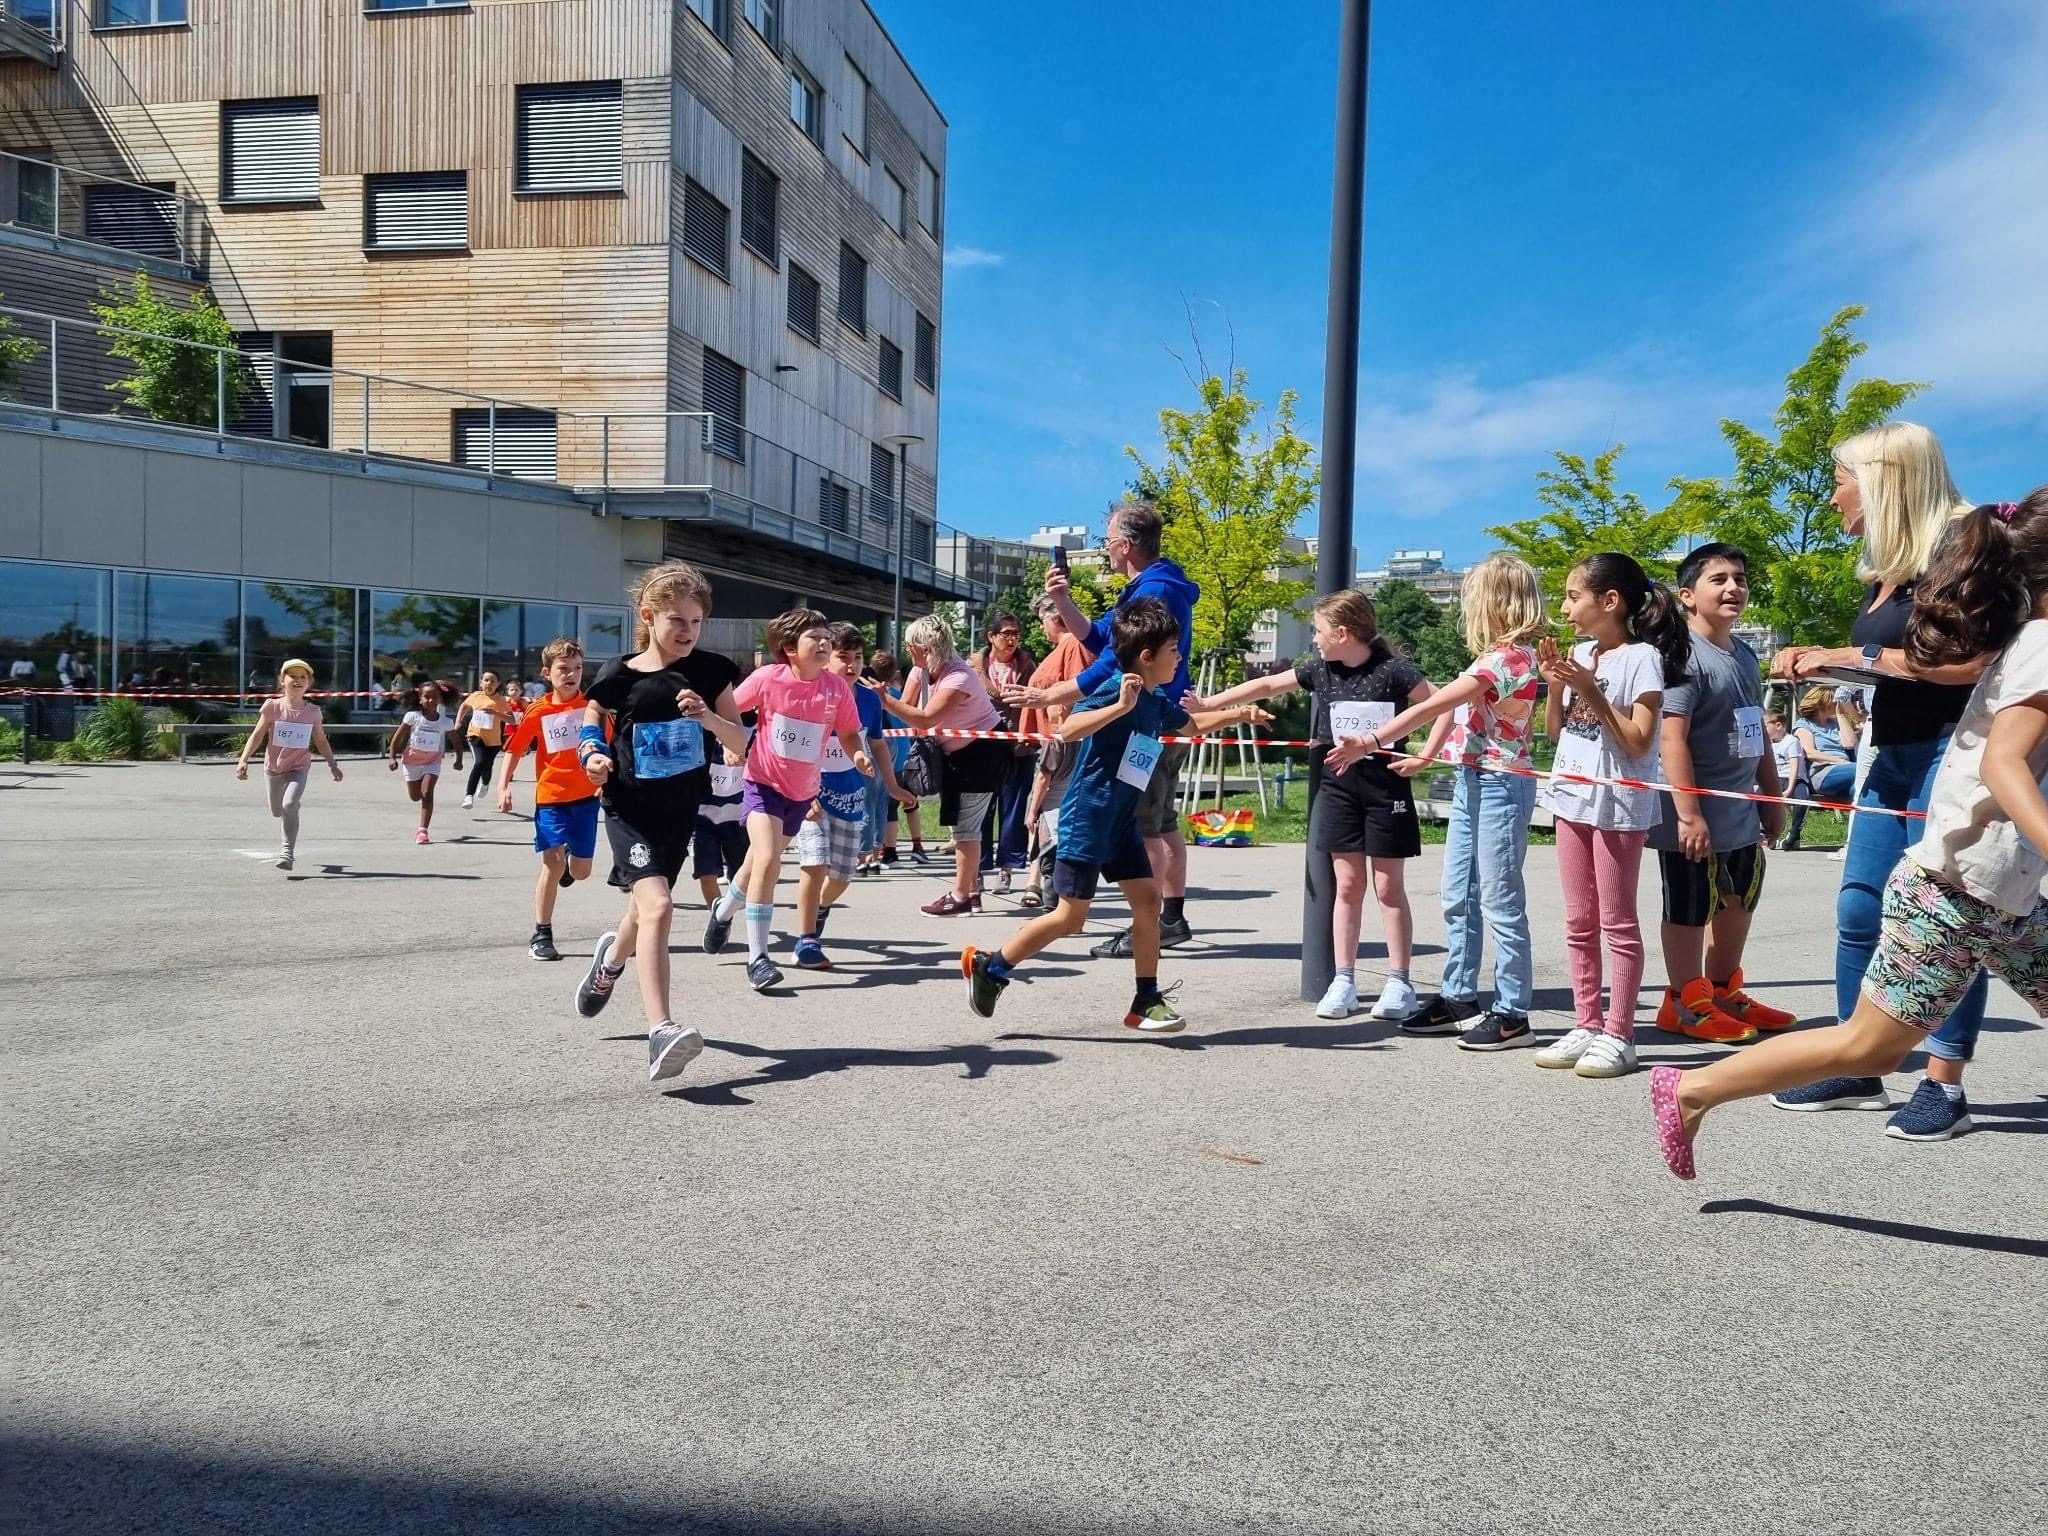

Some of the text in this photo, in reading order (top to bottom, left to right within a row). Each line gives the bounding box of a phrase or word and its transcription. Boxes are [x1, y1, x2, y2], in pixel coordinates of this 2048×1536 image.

[1335, 717, 1360, 730] 279
[278, 729, 293, 738] 187
[549, 726, 569, 740] 182
[775, 729, 811, 747] 169 1c
[825, 748, 843, 759] 141
[1128, 750, 1153, 769] 207
